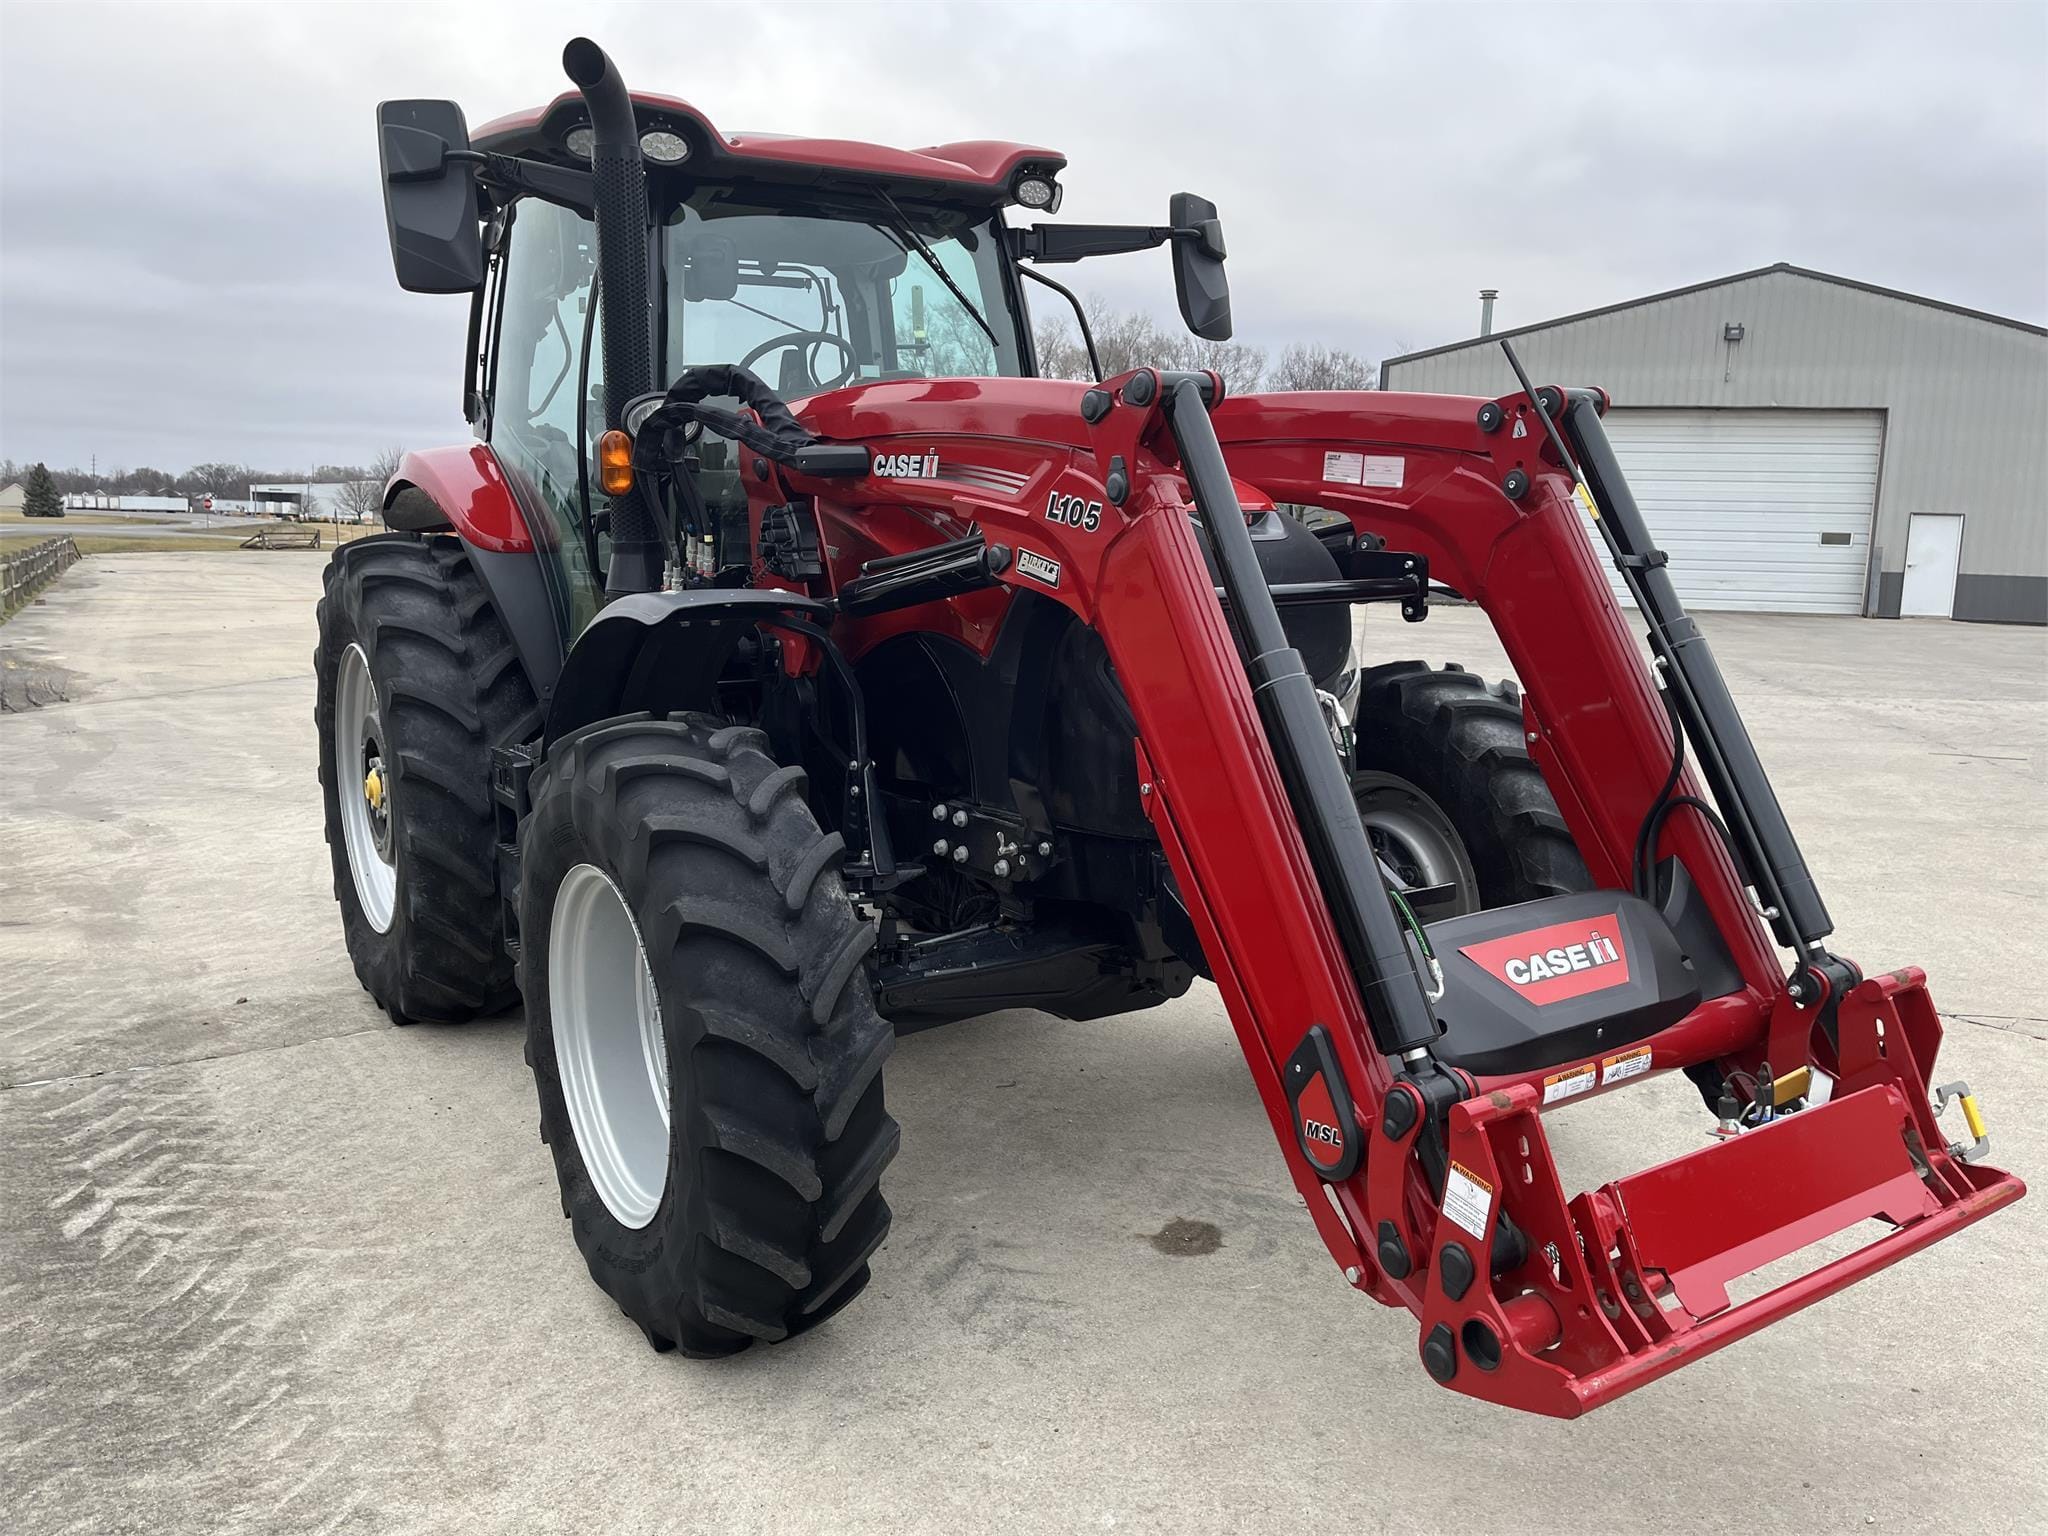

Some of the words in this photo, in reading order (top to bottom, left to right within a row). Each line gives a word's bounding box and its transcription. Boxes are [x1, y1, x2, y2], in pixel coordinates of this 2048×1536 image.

[873, 454, 921, 477] CASE
[1045, 490, 1102, 533] L105
[1504, 943, 1591, 985] CASE
[1620, 1050, 1641, 1063] WARNING
[1562, 1067, 1585, 1081] WARNING
[1305, 1119, 1342, 1147] MSL
[1459, 1166, 1492, 1193] WARNING
